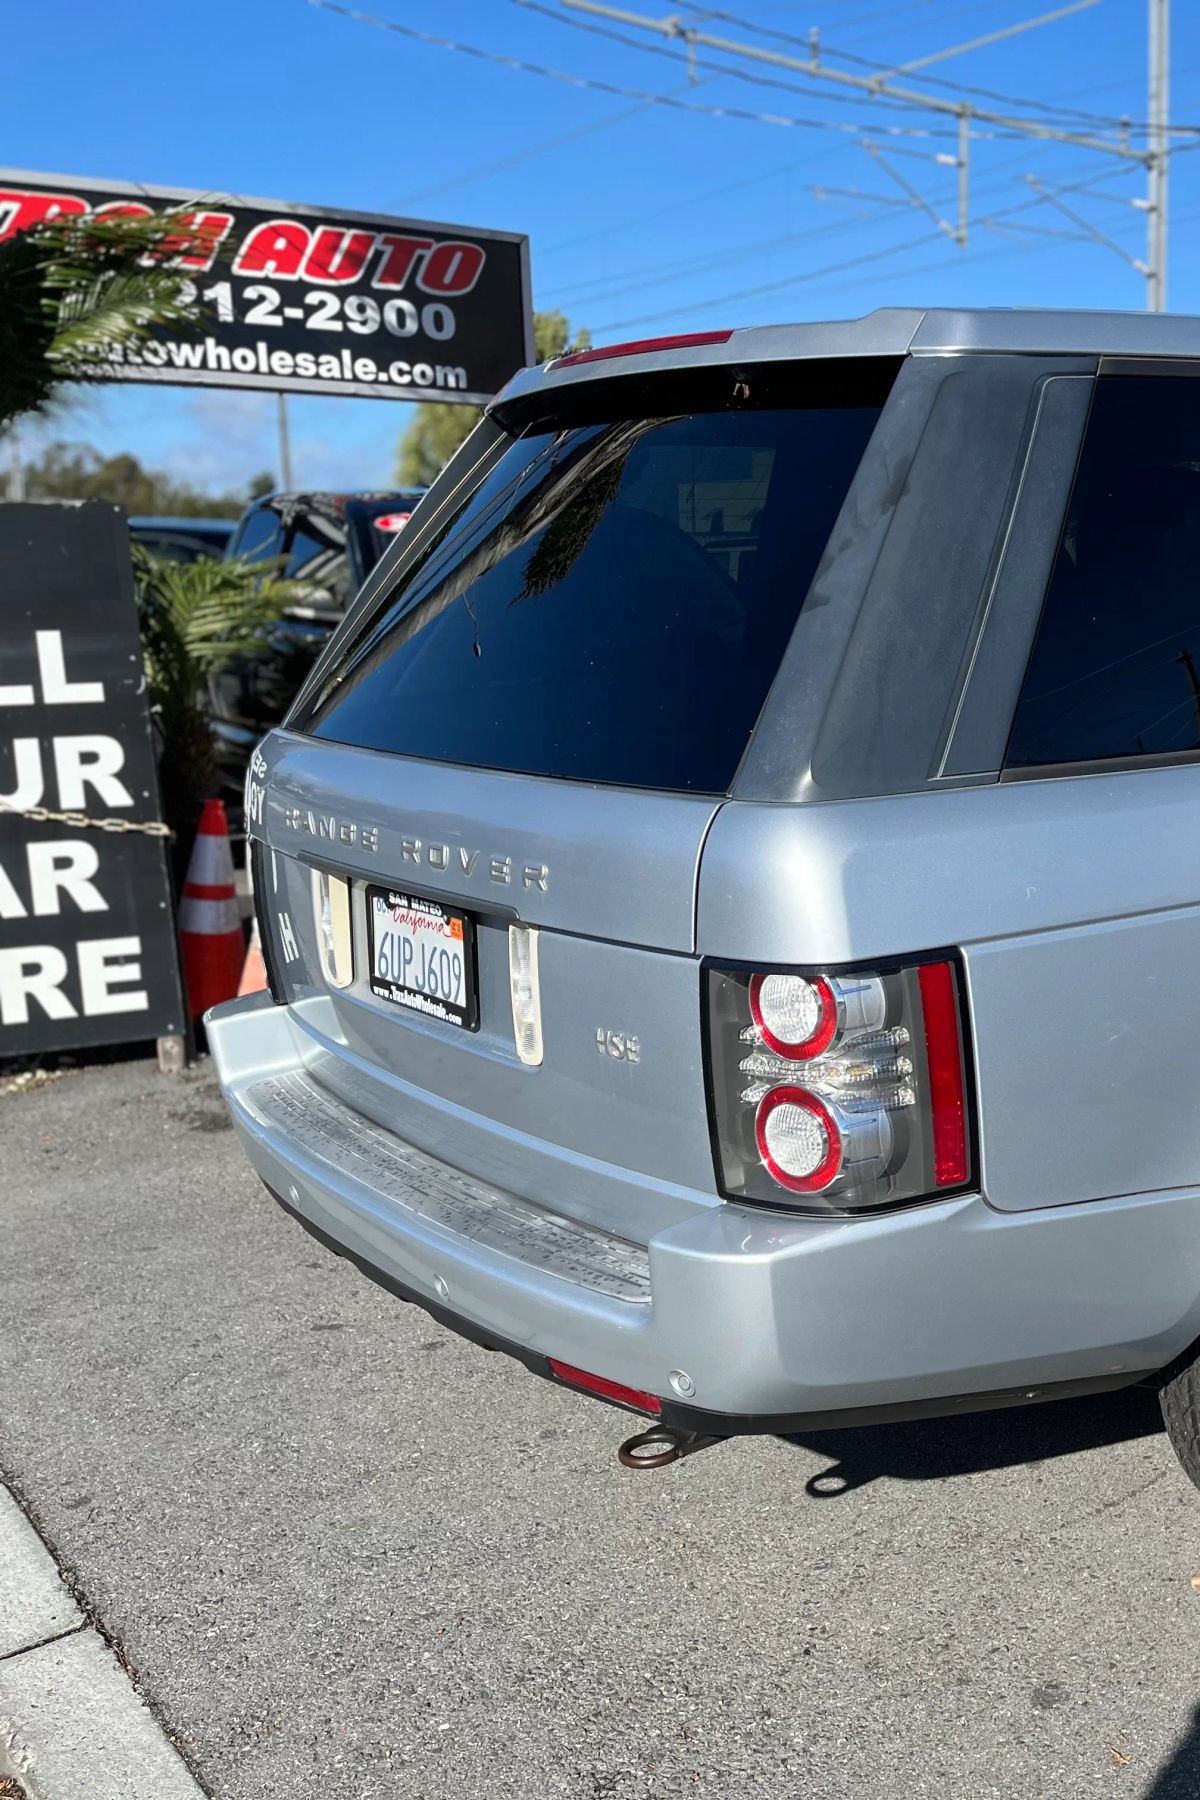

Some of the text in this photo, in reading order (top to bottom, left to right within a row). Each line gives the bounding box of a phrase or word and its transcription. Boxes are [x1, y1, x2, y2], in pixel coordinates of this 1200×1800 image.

[231, 219, 486, 297] AUTO
[402, 838, 549, 892] ROVER
[388, 892, 442, 917] SAN MATEO
[391, 906, 446, 936] California
[378, 931, 462, 1004] 6UPJ609
[596, 1026, 641, 1065] HSE
